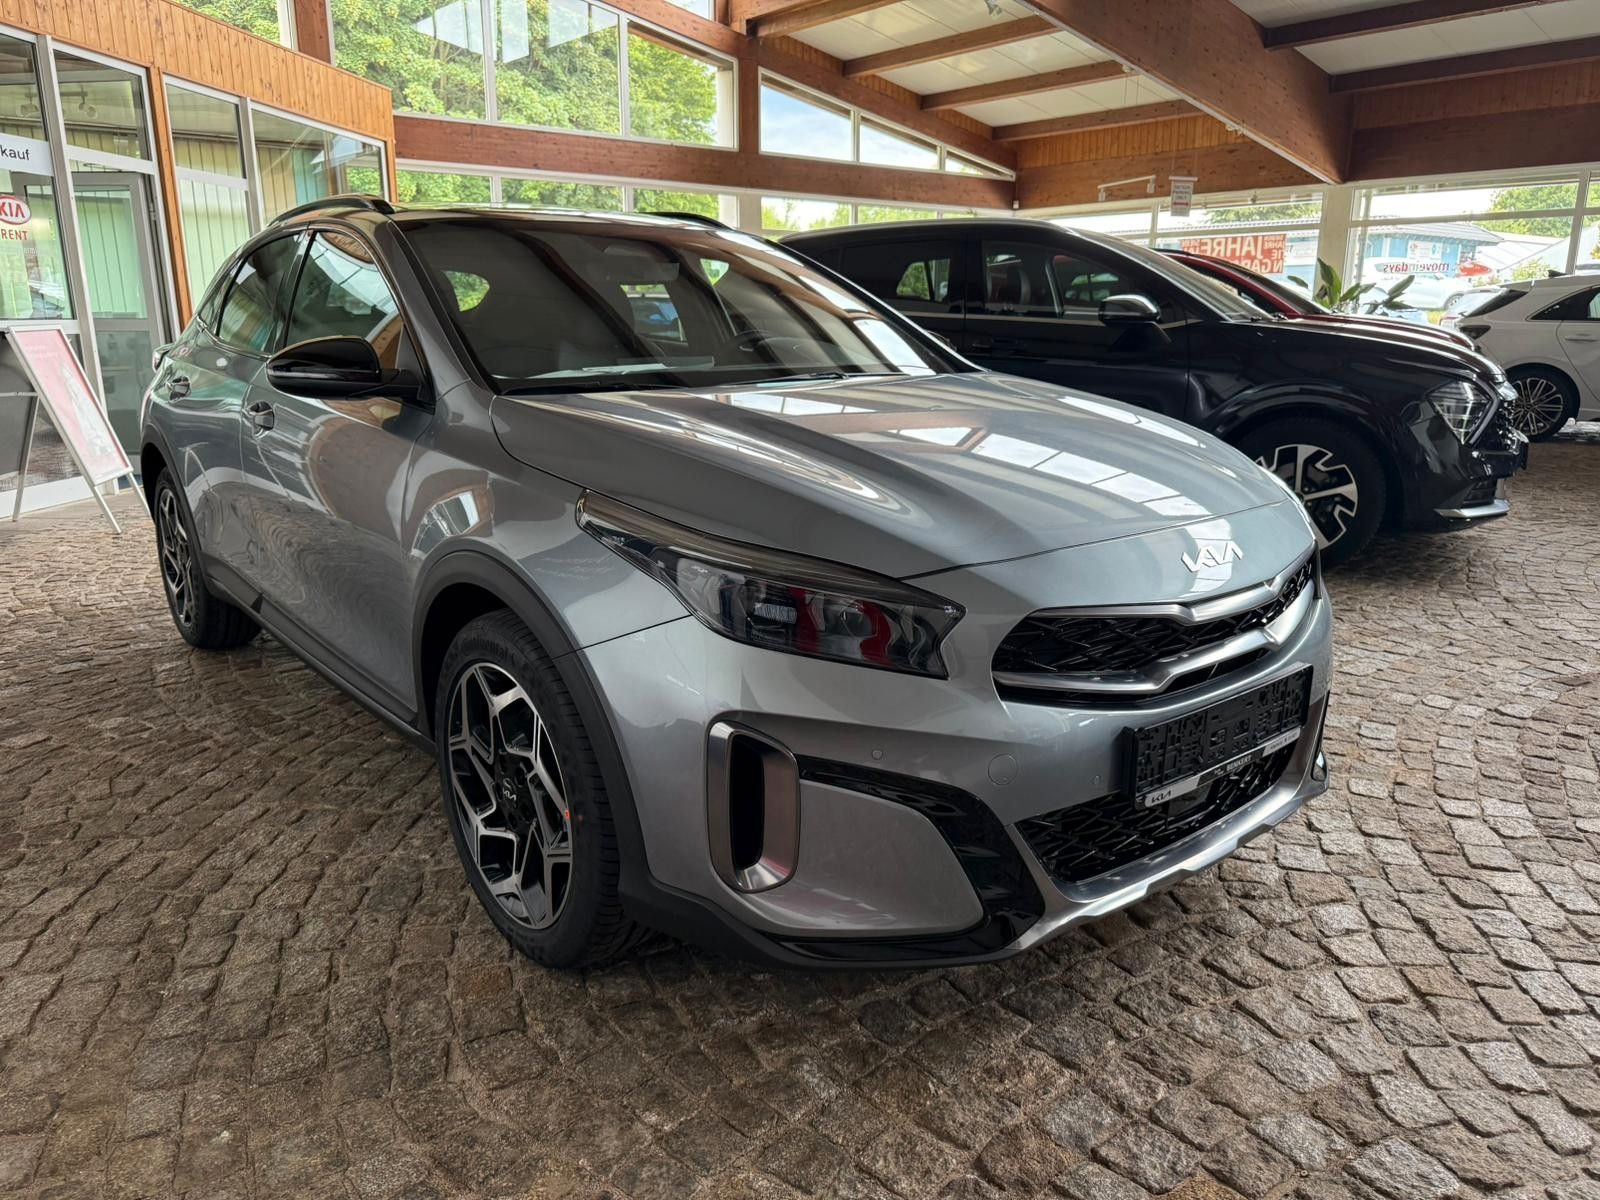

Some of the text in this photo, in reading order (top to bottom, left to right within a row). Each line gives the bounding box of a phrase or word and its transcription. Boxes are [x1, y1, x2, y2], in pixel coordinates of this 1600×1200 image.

[0, 202, 25, 218] KIA
[1, 229, 28, 241] RENT
[1181, 540, 1243, 573] KIA
[1152, 790, 1171, 803] KIA
